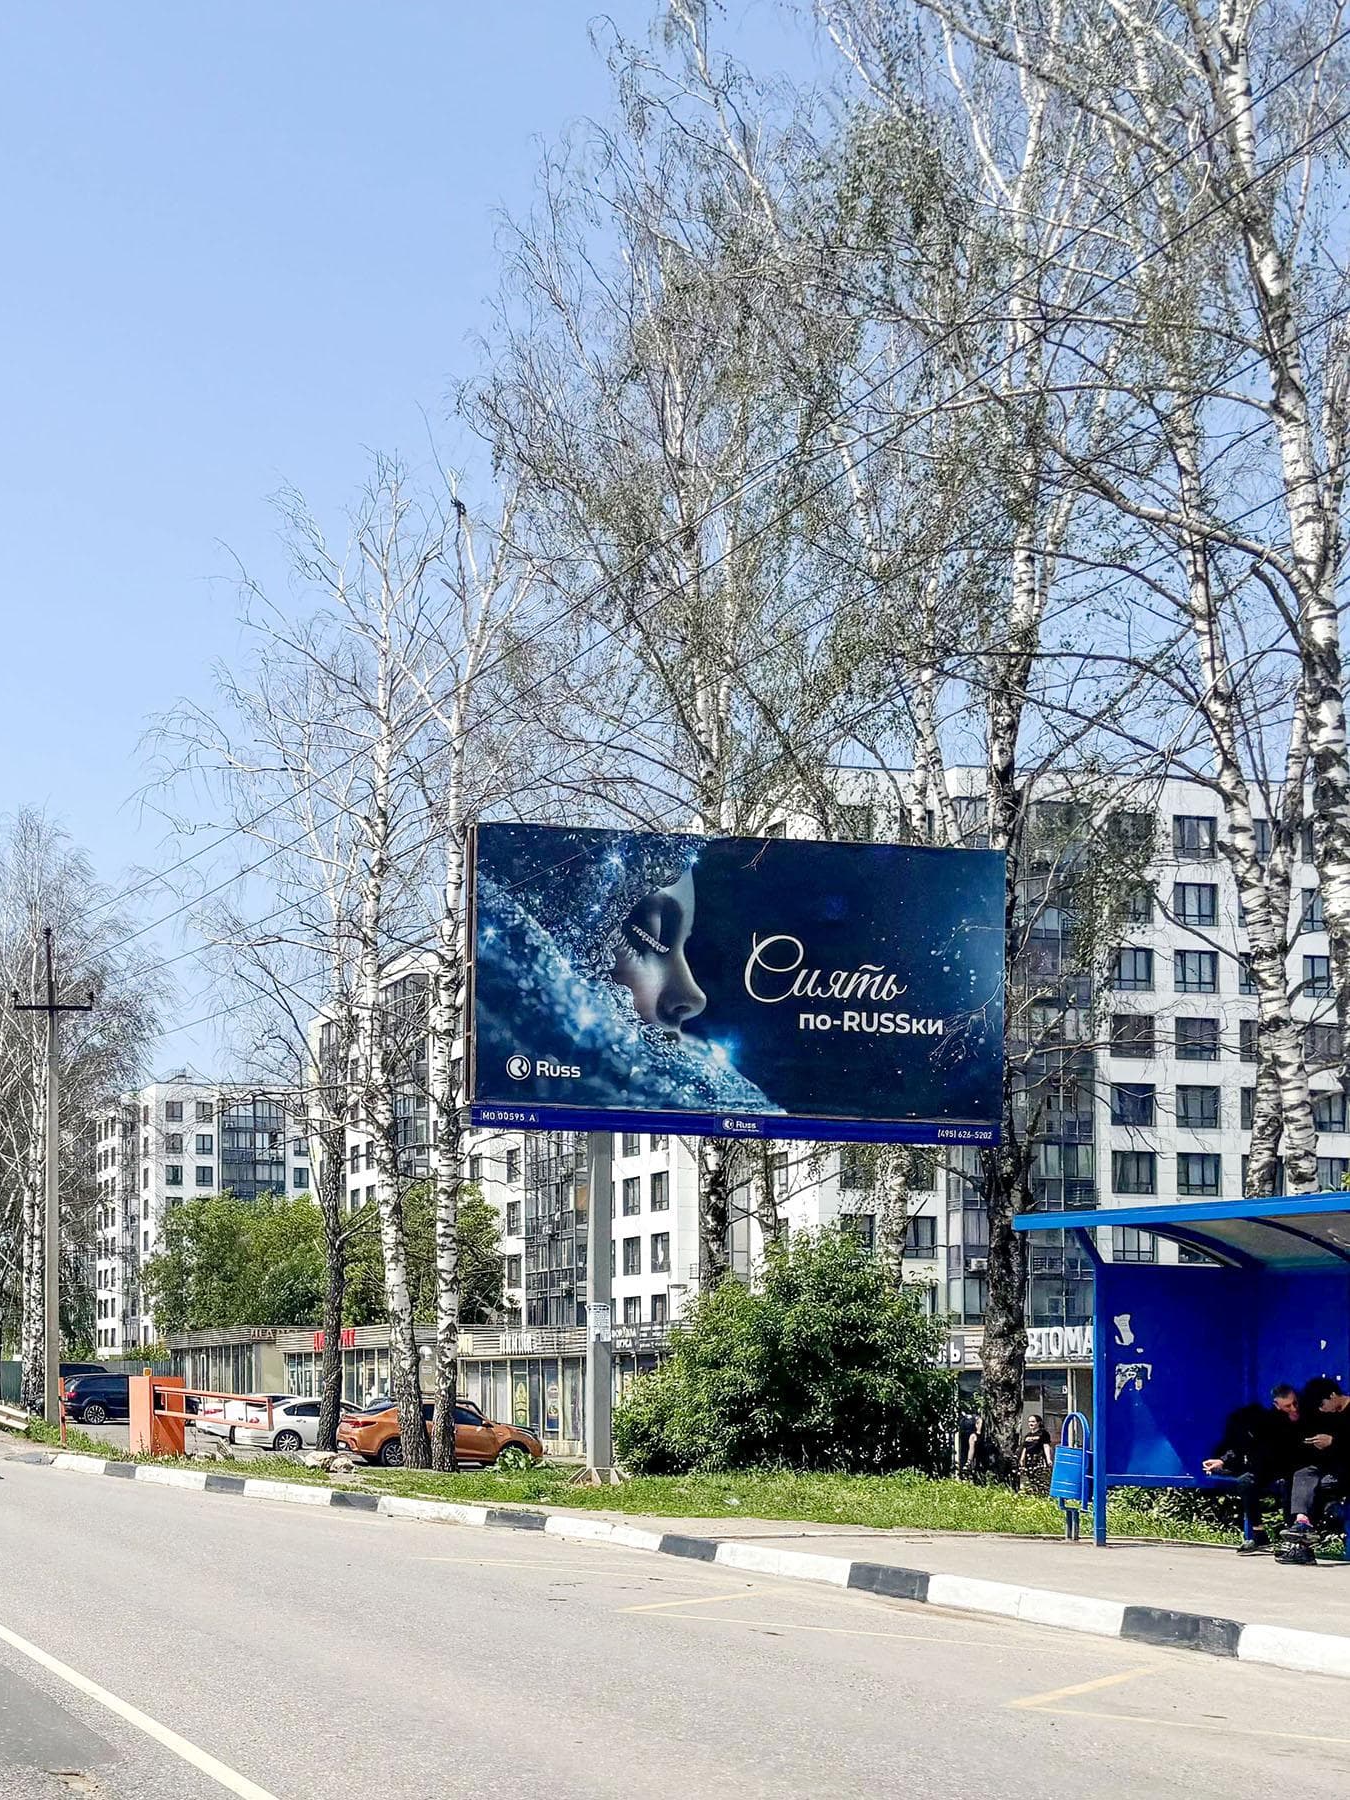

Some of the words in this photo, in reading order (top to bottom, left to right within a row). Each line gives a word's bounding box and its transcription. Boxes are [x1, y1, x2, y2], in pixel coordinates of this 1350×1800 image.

[745, 932, 907, 1002] Сиять
[799, 1011, 943, 1035] по-RUSSки
[536, 1060, 581, 1077] Russ
[736, 1120, 757, 1129] Russ
[958, 1126, 992, 1139] 626-5202
